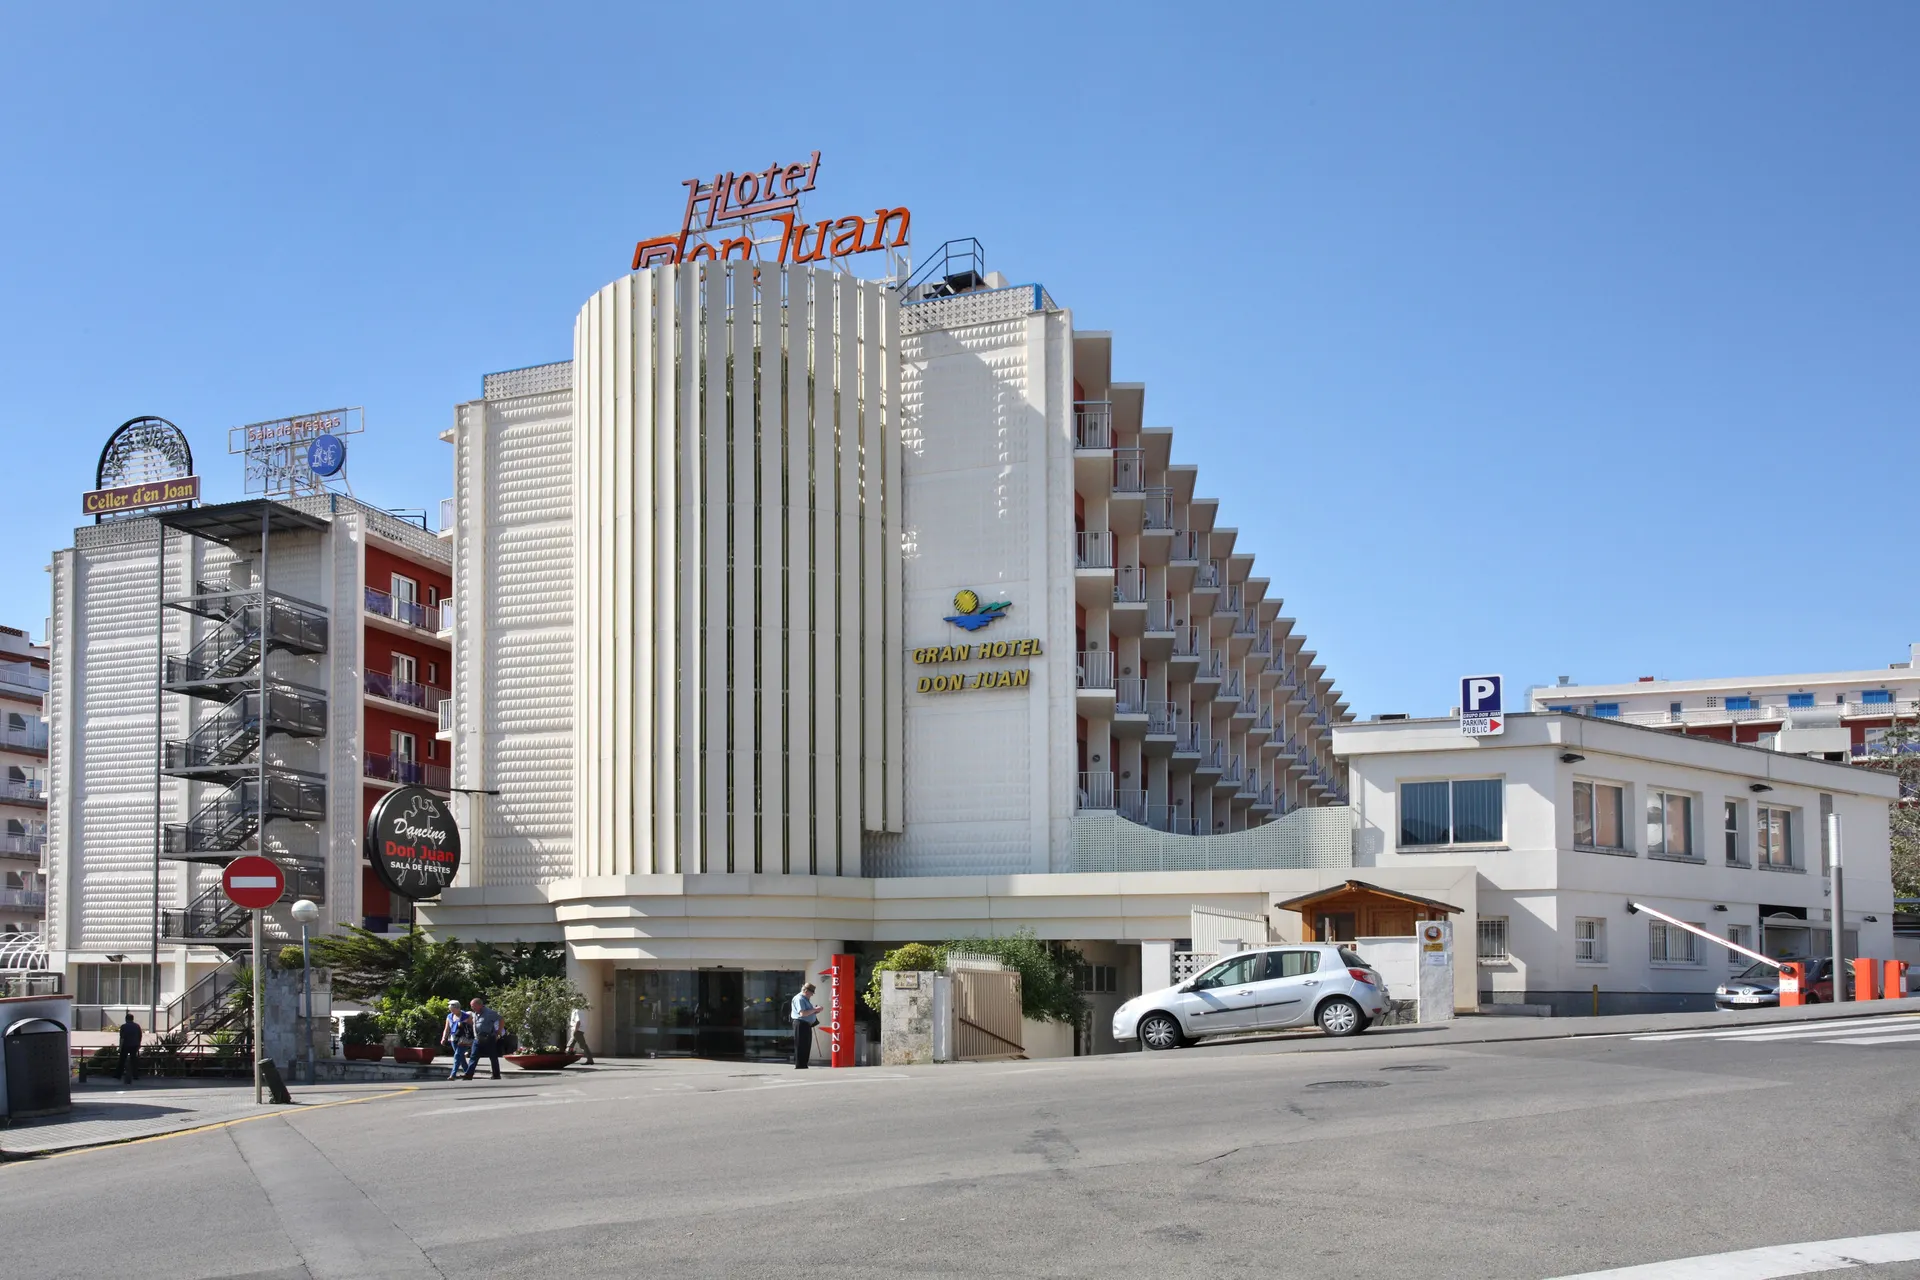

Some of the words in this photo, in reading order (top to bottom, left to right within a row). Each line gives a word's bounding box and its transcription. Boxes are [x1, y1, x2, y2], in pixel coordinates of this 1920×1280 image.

[682, 150, 822, 232] Hotel
[771, 206, 911, 266] Juan
[247, 428, 275, 442] Sala
[276, 425, 292, 437] de
[293, 416, 341, 434] Fiestas
[87, 492, 129, 511] Celler
[132, 485, 159, 504] d'en
[163, 483, 193, 500] Joan
[912, 644, 971, 664] GRAN
[978, 638, 1043, 660] HOTEL
[916, 674, 965, 693] DON
[970, 668, 1030, 689] JUAN
[1469, 679, 1495, 711] P
[1462, 718, 1488, 727] PARKING
[1462, 726, 1488, 734] PUBLIC
[393, 818, 446, 845] Dancing
[384, 840, 416, 858] Don
[420, 845, 455, 863] Juan
[390, 861, 411, 870] SALA
[412, 863, 422, 871] DE
[424, 865, 451, 874] FESTES
[831, 966, 840, 1053] TELÉFONO
